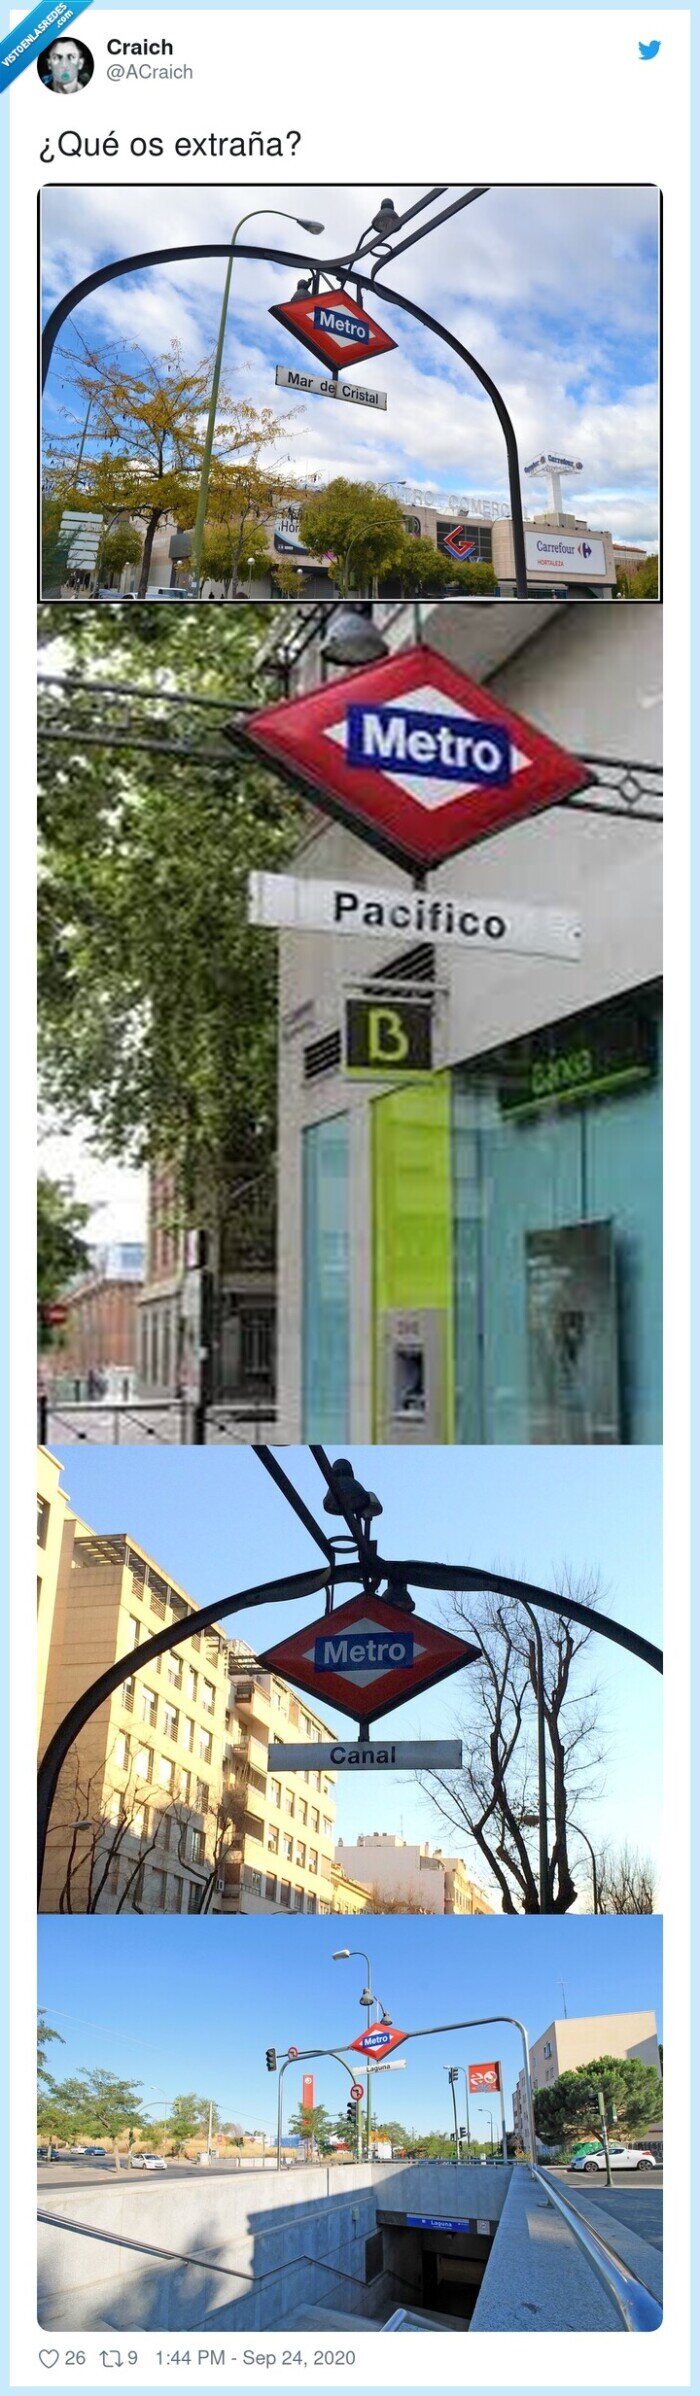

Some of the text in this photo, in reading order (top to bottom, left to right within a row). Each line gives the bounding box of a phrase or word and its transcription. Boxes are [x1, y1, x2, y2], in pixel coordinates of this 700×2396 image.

[320, 311, 366, 338] Metro
[287, 371, 379, 404] Mar de Cristal
[536, 540, 575, 555] Carrefour
[362, 714, 502, 773] Metro
[334, 891, 507, 939] Pacifico
[369, 1008, 409, 1061] B
[324, 1640, 406, 1664] Metro
[330, 1746, 397, 1765] Canal
[364, 2035, 388, 2046] Metro
[366, 2064, 391, 2073] Laguna
